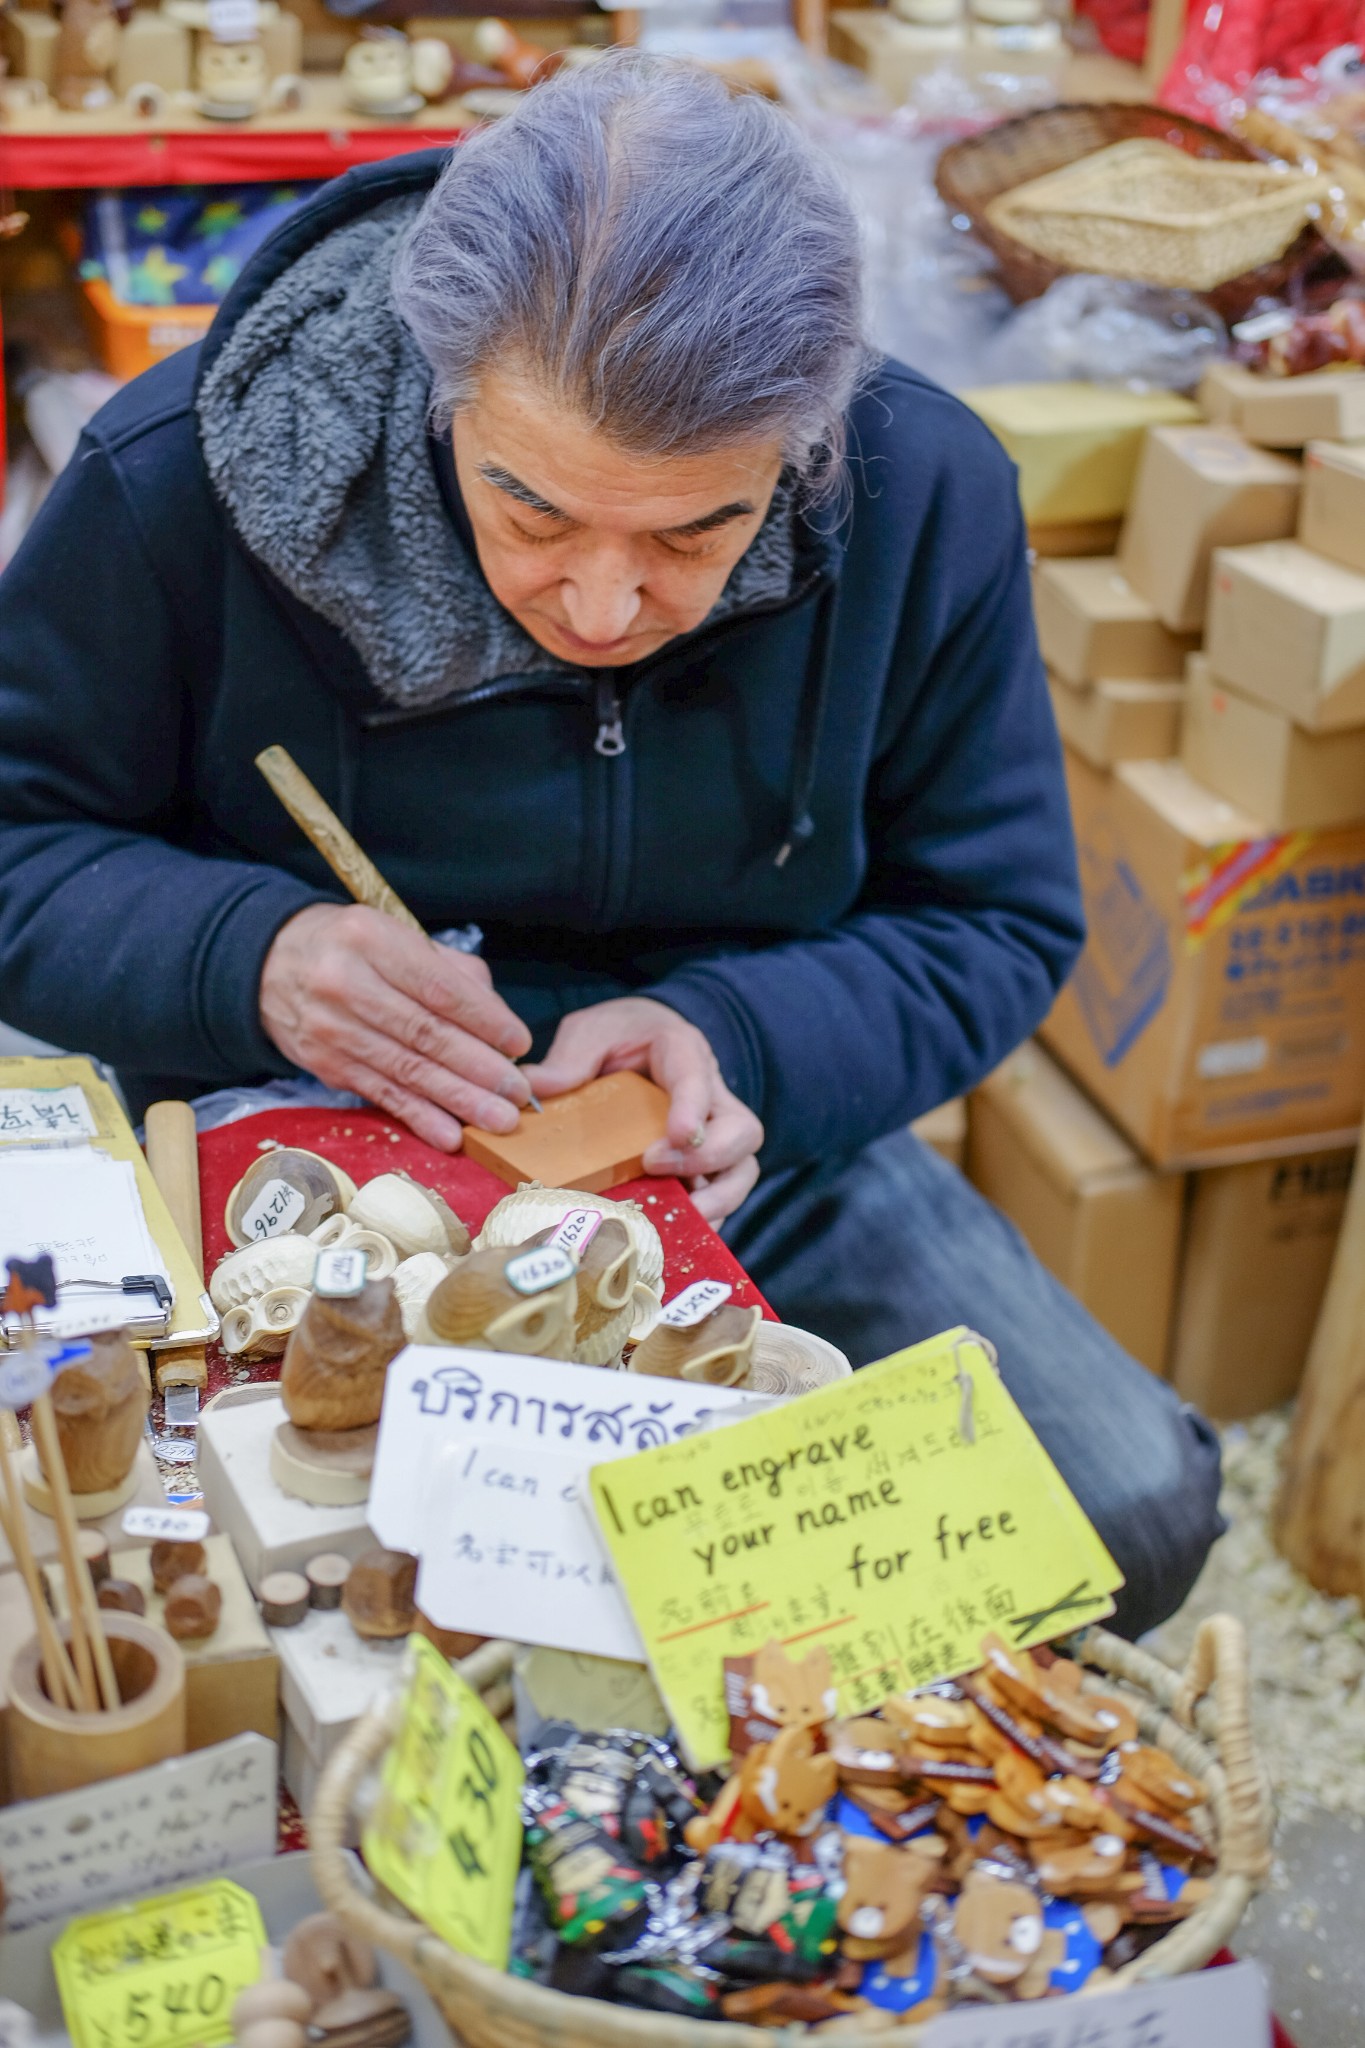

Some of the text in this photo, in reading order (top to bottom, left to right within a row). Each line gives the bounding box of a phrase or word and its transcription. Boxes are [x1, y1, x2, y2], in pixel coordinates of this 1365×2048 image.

[483, 1466, 539, 1497] can
[600, 1484, 626, 1534] I
[632, 1483, 702, 1530] can
[722, 1423, 875, 1497] engrave
[693, 1478, 902, 1575] your name
[848, 1509, 1019, 1588] for free
